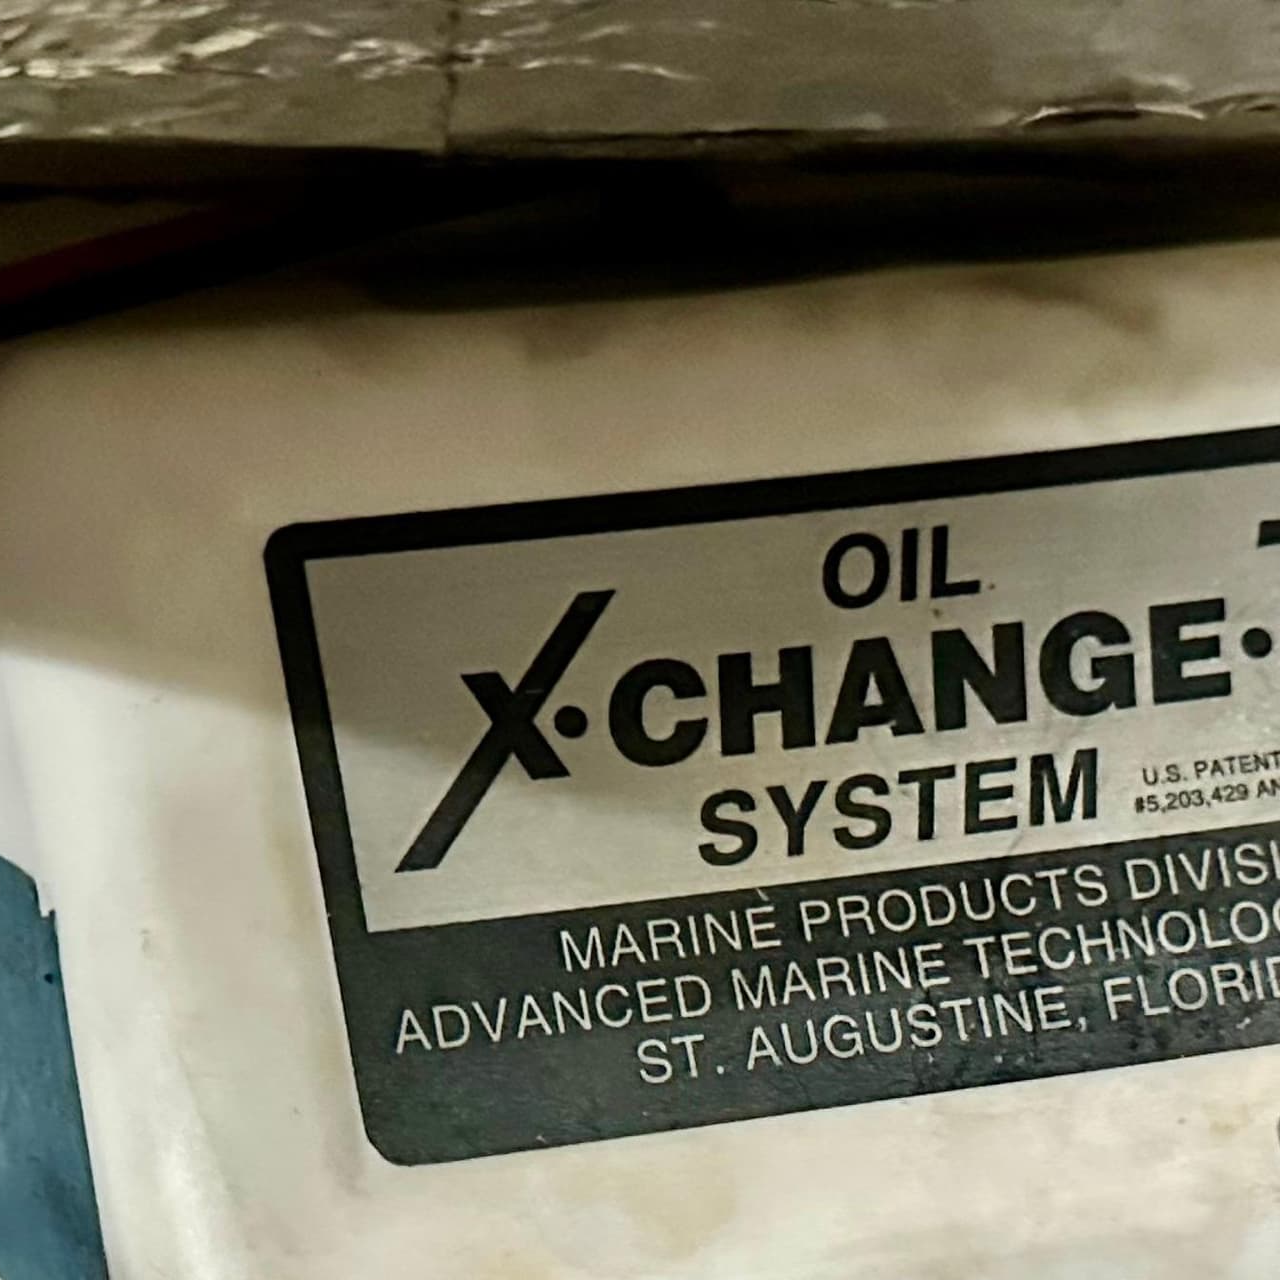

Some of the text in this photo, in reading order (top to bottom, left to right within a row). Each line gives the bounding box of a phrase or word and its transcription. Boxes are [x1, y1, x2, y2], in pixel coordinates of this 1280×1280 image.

[822, 525, 981, 609] OIL
[698, 747, 1099, 866] SYSTEM
[1134, 783, 1249, 814] #5,203,429
[1142, 764, 1188, 786] U.S.
[559, 905, 782, 972] MARINE
[801, 864, 1109, 943] PRODUCTS
[395, 974, 713, 1054] ADVANCED
[730, 942, 951, 1012] MARINE
[637, 1033, 725, 1084] ST.
[746, 986, 1087, 1072] AUGUSTINE,
